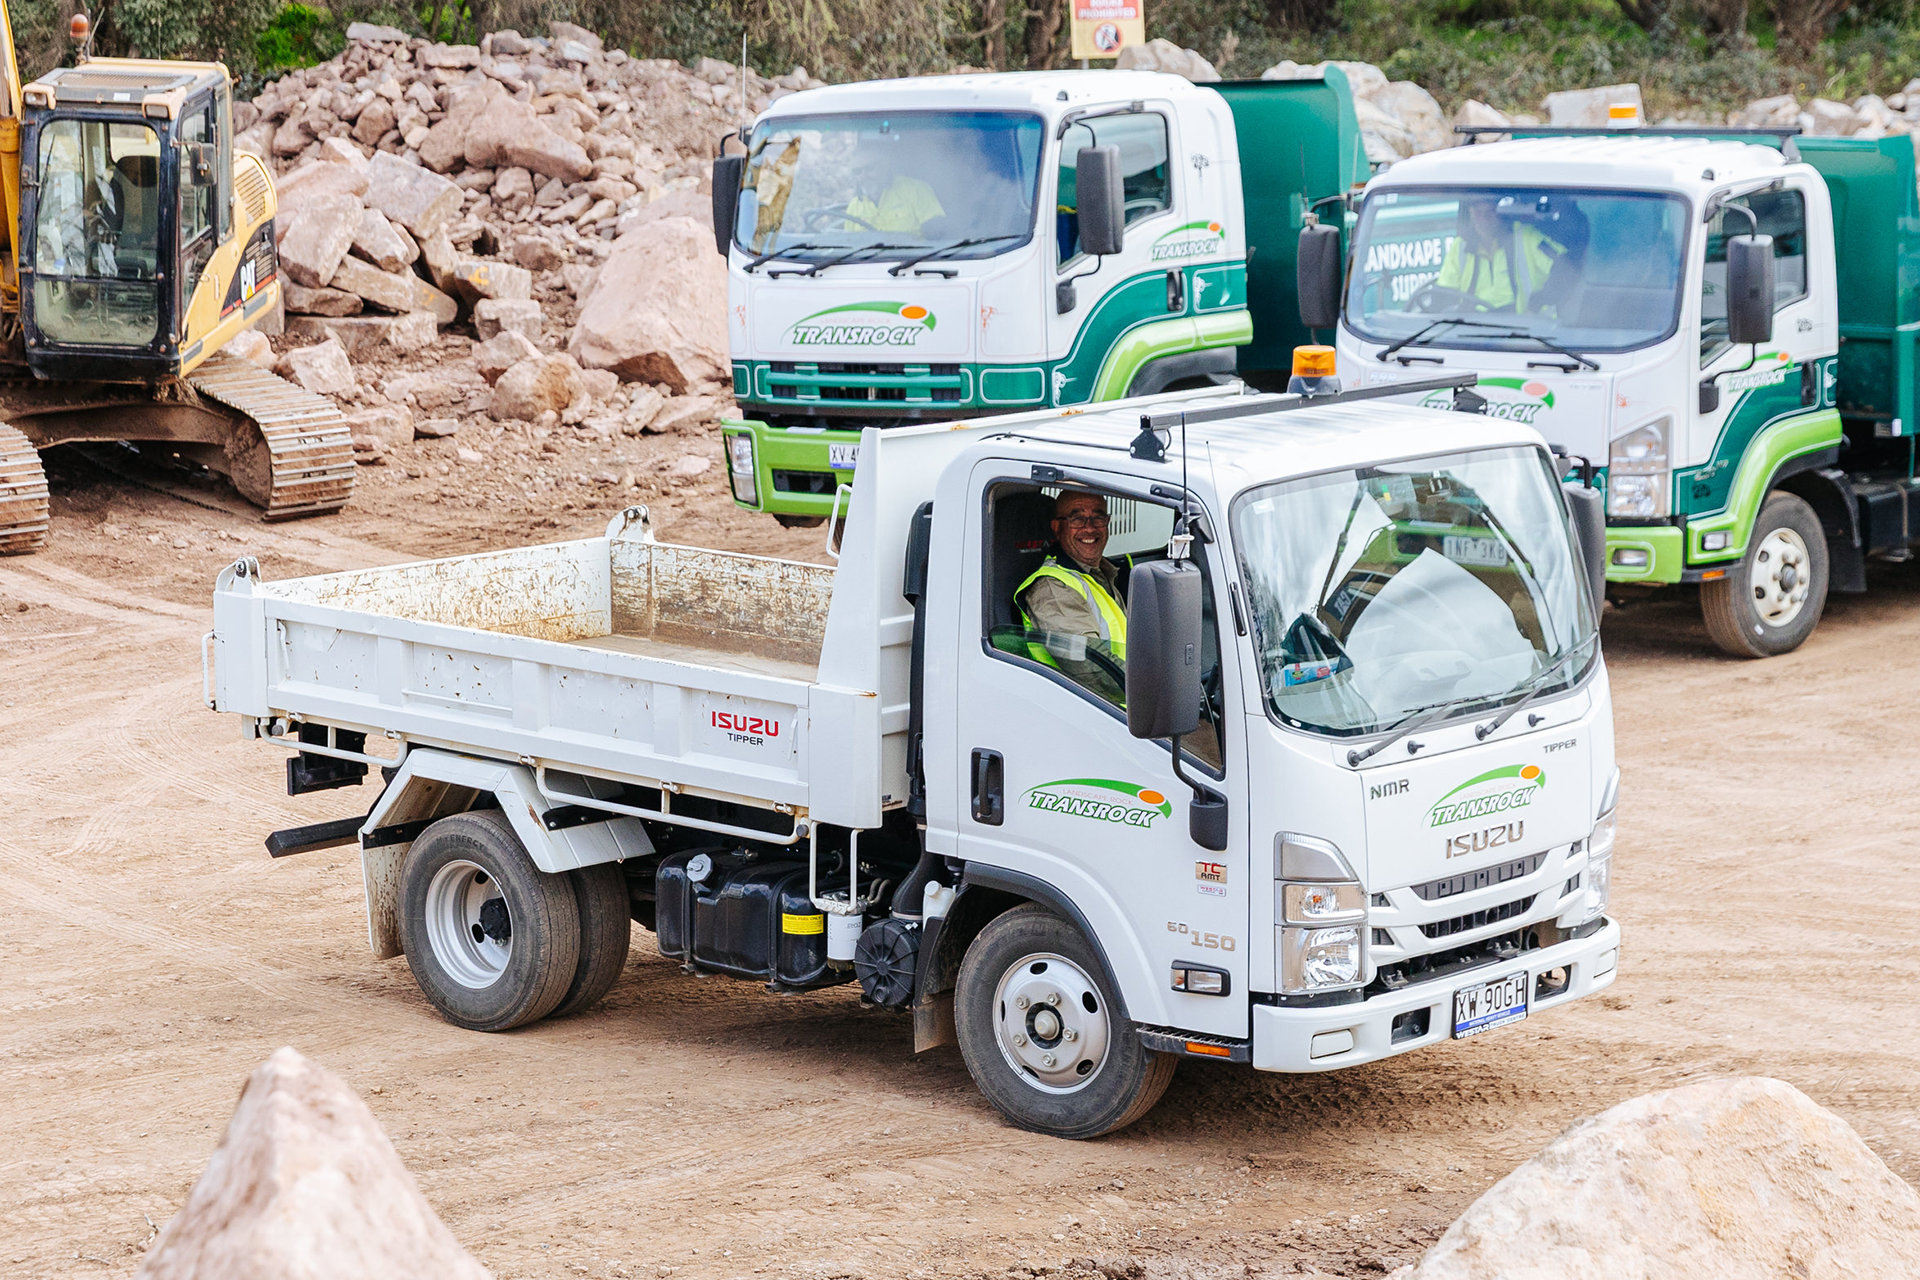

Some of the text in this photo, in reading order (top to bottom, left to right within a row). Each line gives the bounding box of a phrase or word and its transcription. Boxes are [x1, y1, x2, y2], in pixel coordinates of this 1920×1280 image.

[1152, 237, 1219, 261] TRANSROCK
[1363, 238, 1442, 273] ANDSCAPE
[240, 258, 256, 301] CAT
[792, 326, 924, 346] TRANSROCK
[712, 710, 779, 737] ISUZU
[727, 732, 764, 746] TIPPER
[1543, 738, 1577, 753] TIPPER
[1062, 788, 1133, 806] LANDSCAPE ROCK
[1370, 778, 1410, 800] NMR
[1029, 790, 1161, 829] TRANSROCK
[1430, 785, 1538, 828] TRANSROCK
[1446, 820, 1525, 860] ISUZU
[1201, 862, 1221, 874] TC
[1201, 872, 1220, 881] AMT
[1191, 930, 1236, 952] 150
[1456, 1024, 1490, 1039] WESTAR
